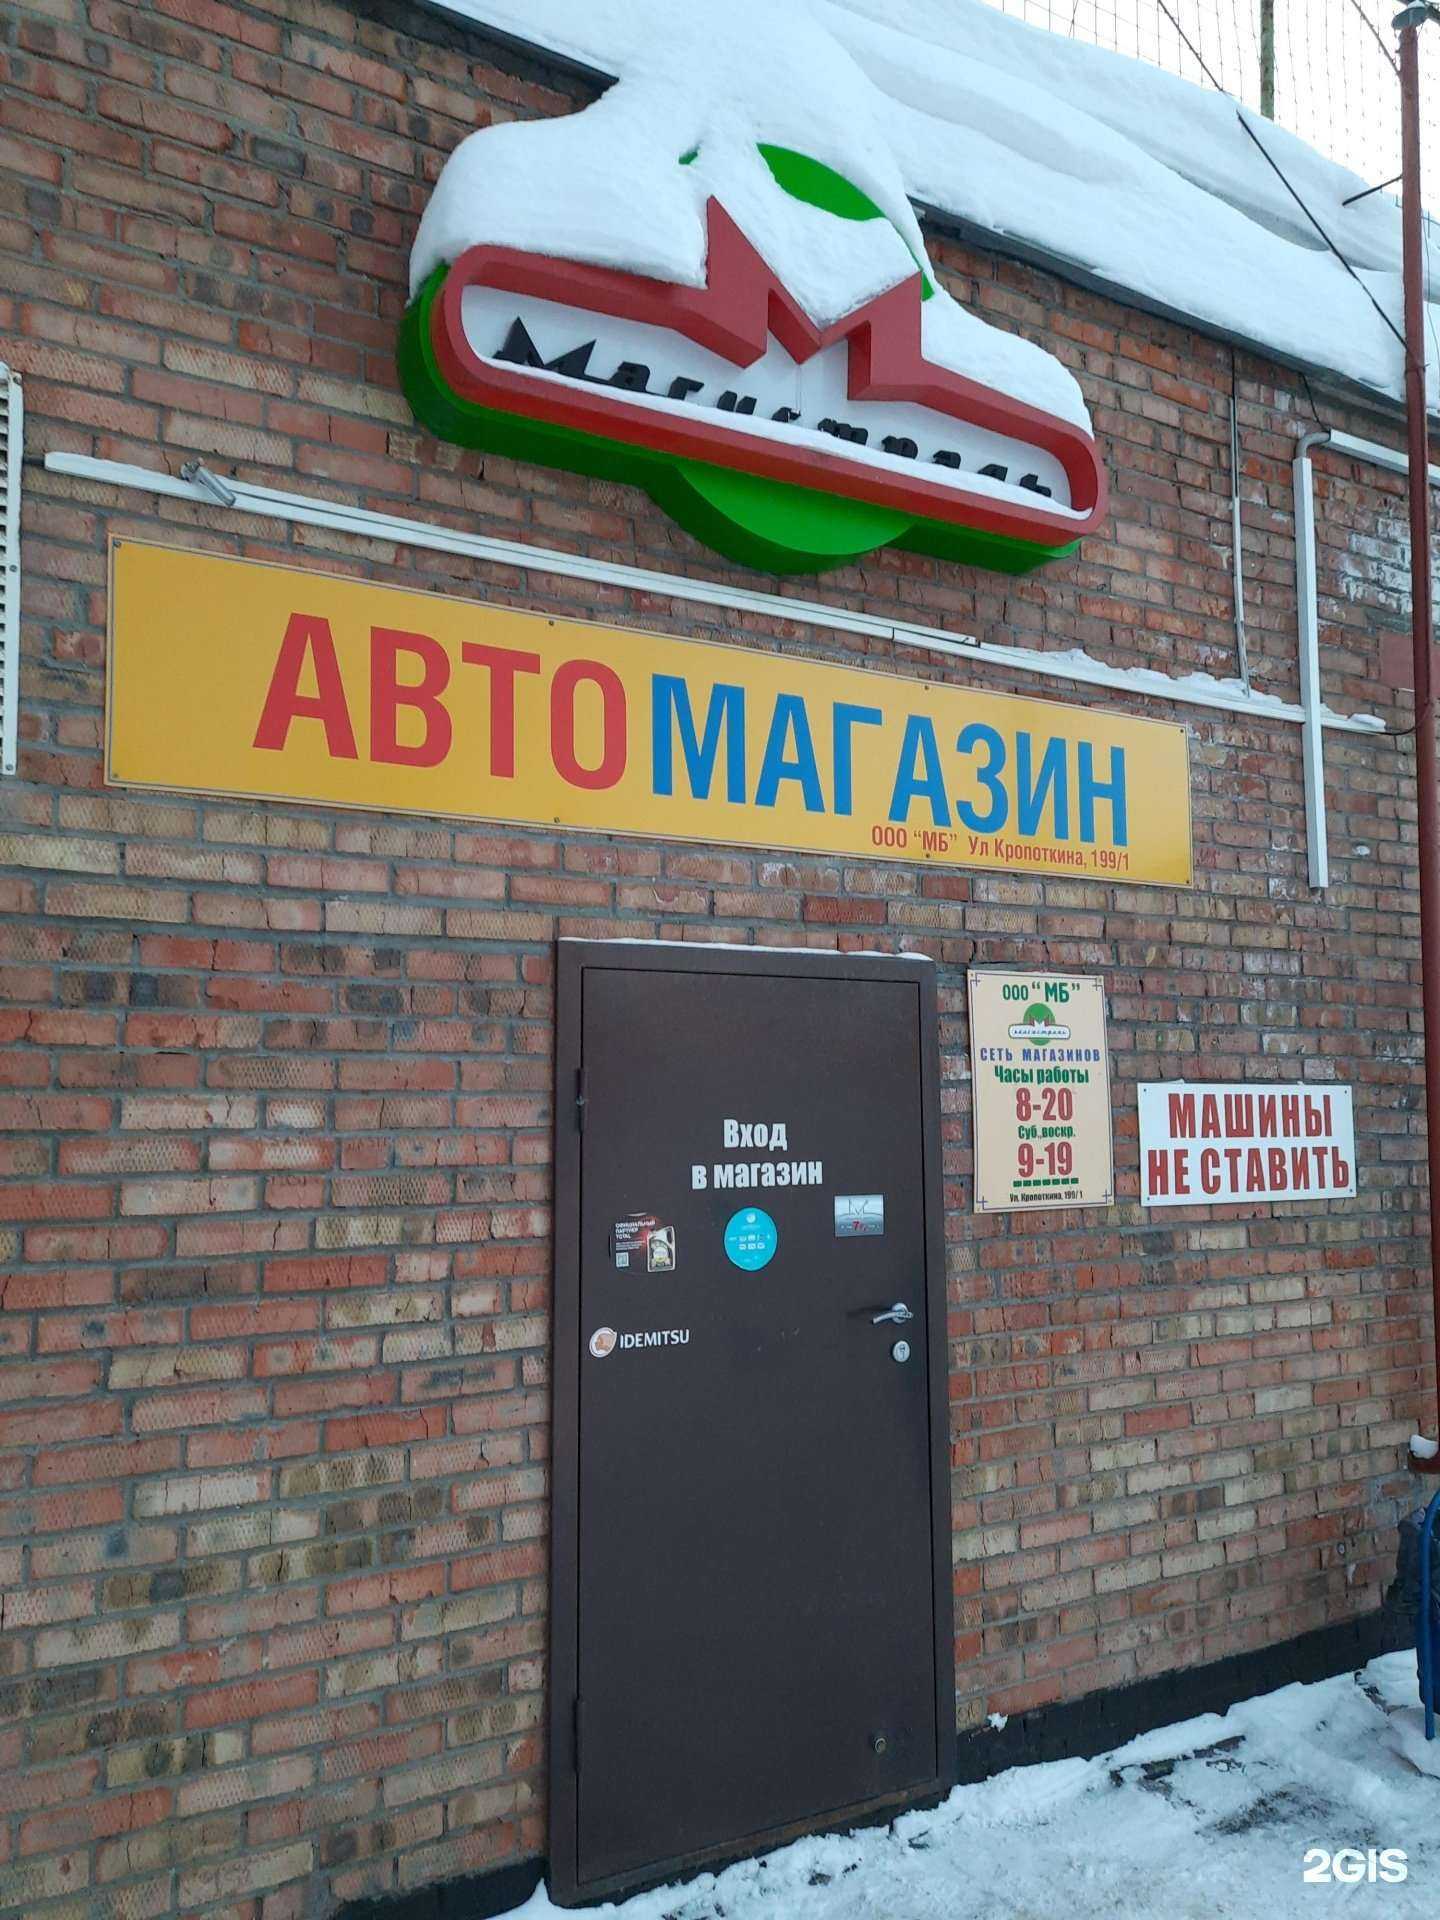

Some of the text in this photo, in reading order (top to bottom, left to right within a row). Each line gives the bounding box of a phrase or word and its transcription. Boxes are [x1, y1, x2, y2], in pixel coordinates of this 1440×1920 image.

[252, 612, 1128, 847] АВТОМАГАЗИН
[871, 825, 908, 849] ООО
[968, 835, 989, 857] Ул
[994, 838, 1087, 869] Кропоткина,
[1090, 850, 1130, 871] 199/1
[1002, 984, 1029, 1001] ООО
[980, 1047, 1101, 1062] СЕТЬ МАГАЗИНОВ
[994, 1065, 1089, 1085] Часы работы
[1015, 1087, 1074, 1122] 8-20
[1168, 1093, 1333, 1138] МАШИНЫ
[723, 1118, 788, 1151] Вход
[691, 1160, 823, 1190] в магазин
[1018, 1141, 1073, 1178] 9-19
[1147, 1146, 1349, 1196] НЕ СТАВИТЬ
[619, 1328, 690, 1349] IDEMITSU
